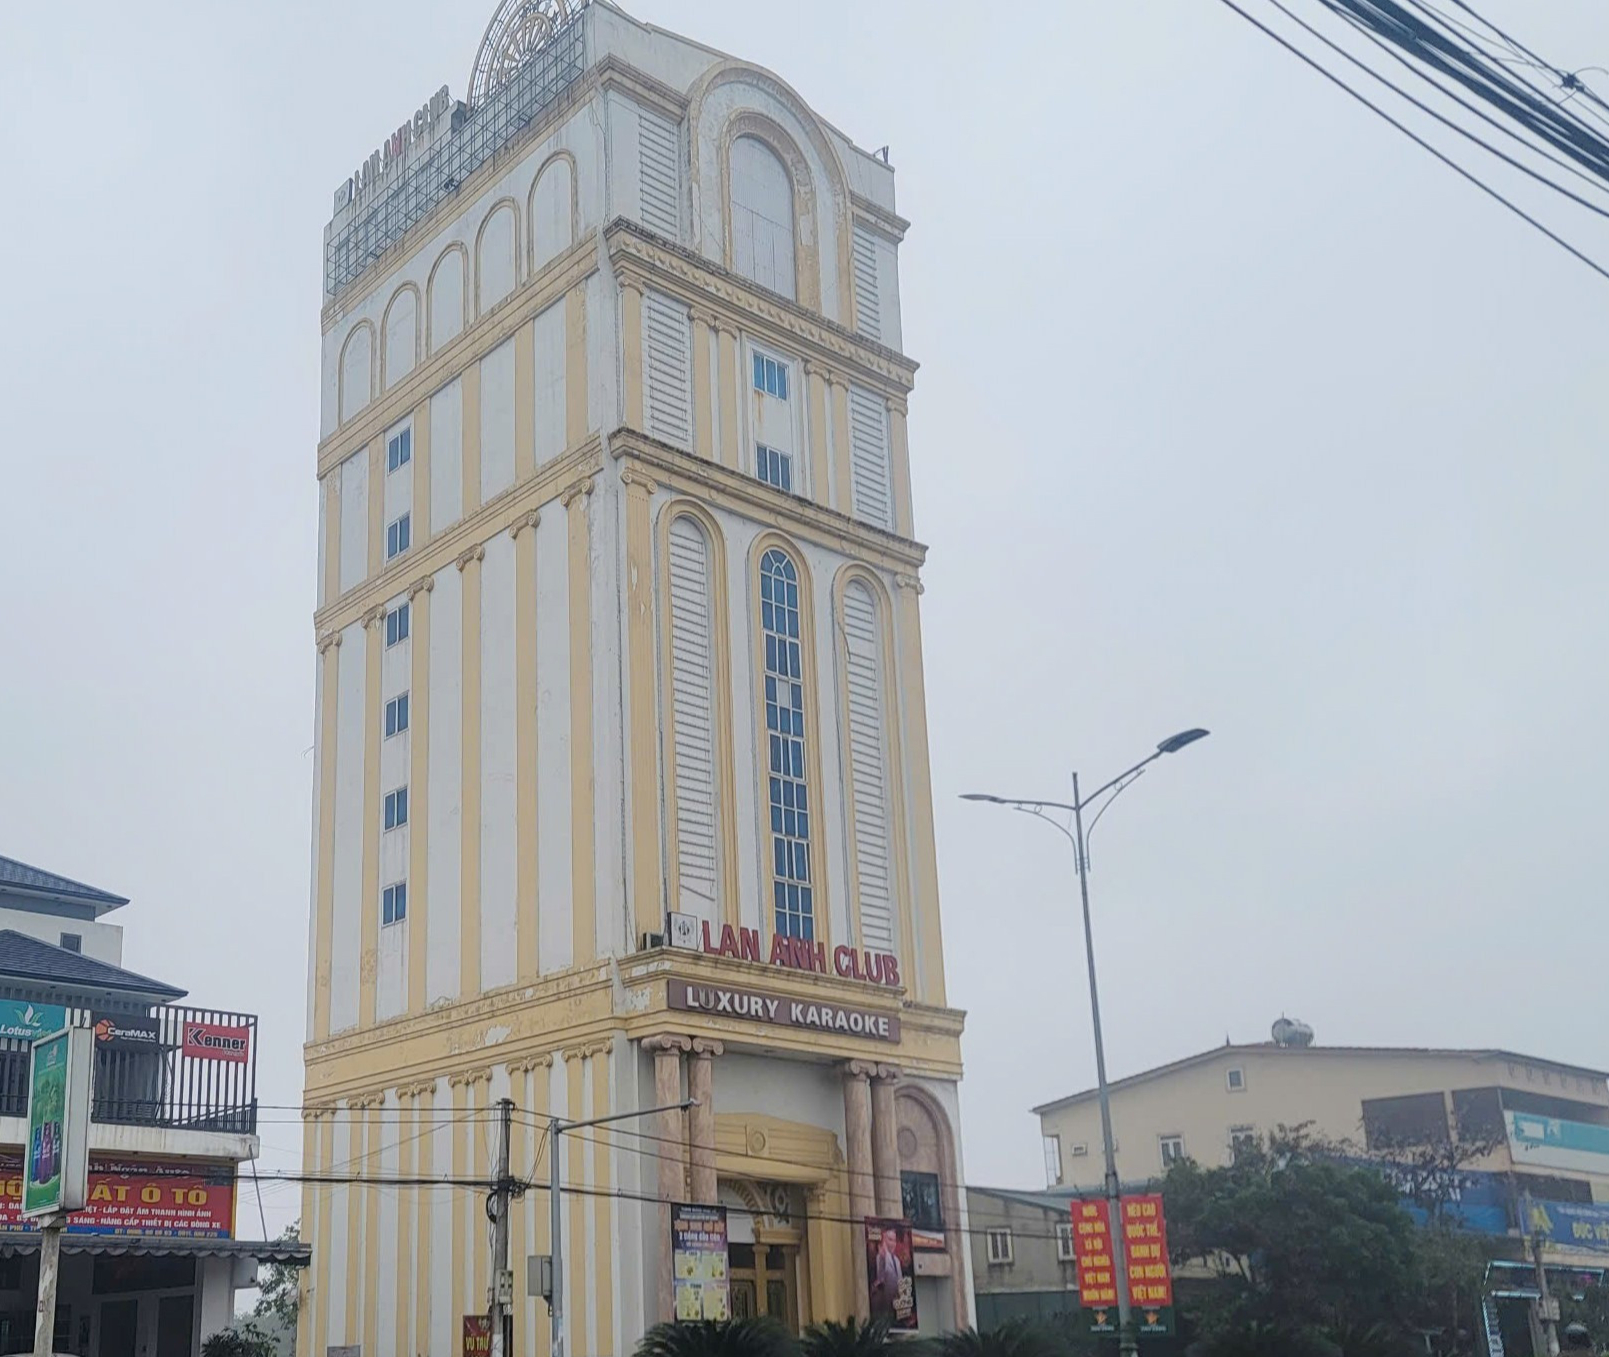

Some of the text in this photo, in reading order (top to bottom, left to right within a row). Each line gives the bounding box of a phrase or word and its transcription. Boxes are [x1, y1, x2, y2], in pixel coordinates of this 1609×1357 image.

[702, 920, 900, 986] LAN ANH CLUB
[686, 986, 889, 1036] LUXURY KARAOKE
[107, 1027, 156, 1039] CeraMAX
[187, 1027, 246, 1050] Kenner
[90, 1178, 207, 1205] ẤT Ô TÔ
[151, 1208, 176, 1217] THANH
